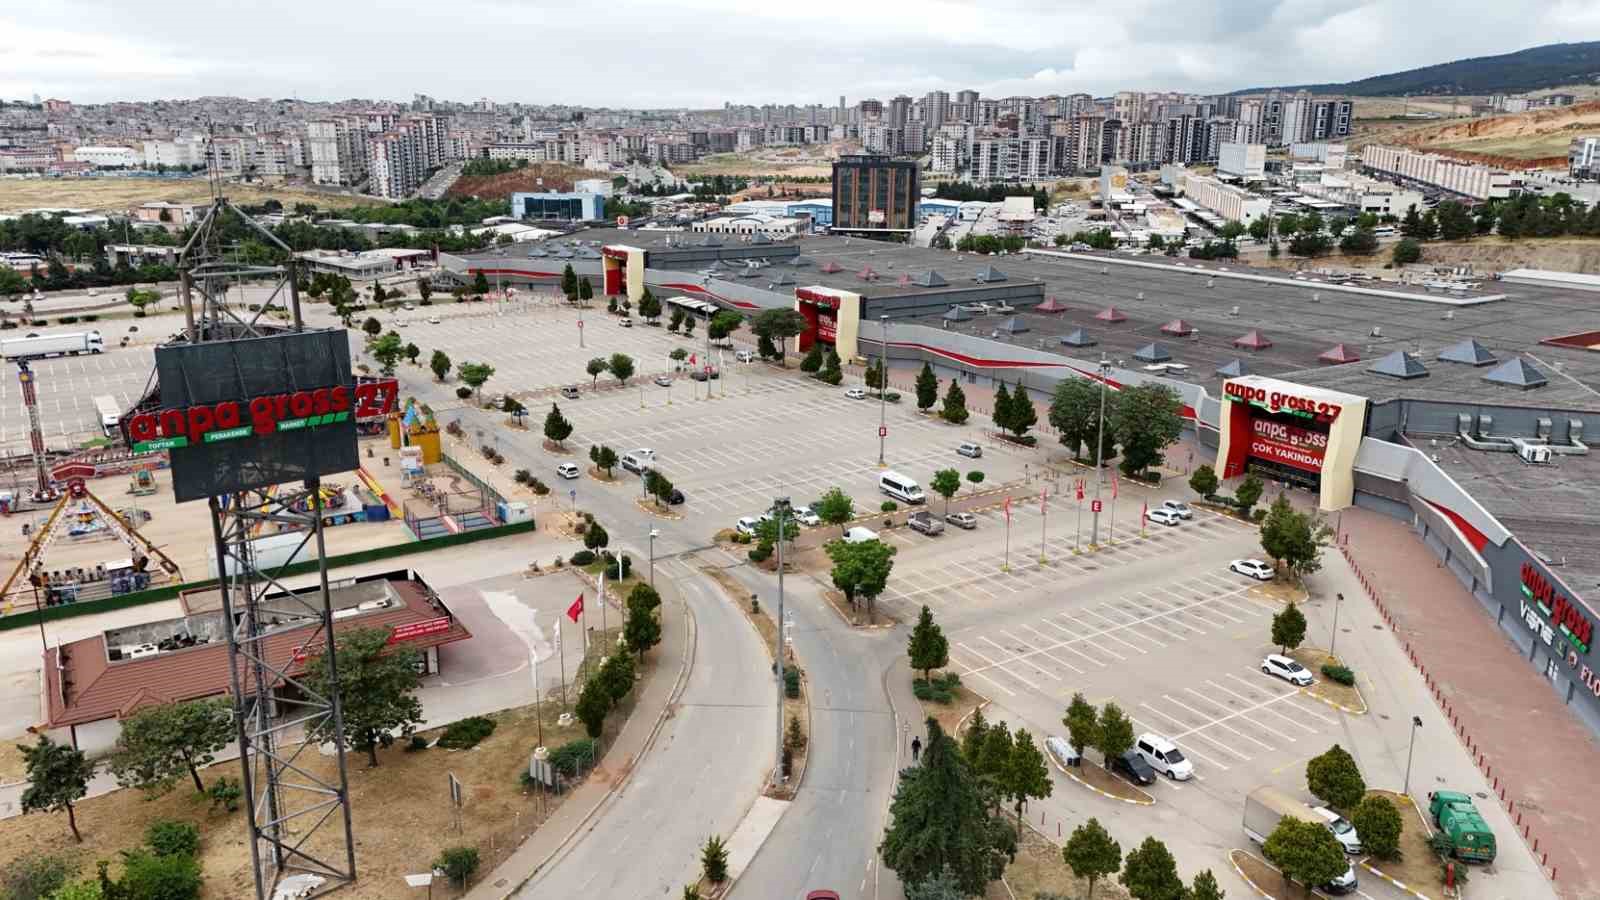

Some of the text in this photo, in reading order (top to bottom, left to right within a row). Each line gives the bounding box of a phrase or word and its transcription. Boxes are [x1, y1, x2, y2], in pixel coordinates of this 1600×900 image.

[130, 379, 398, 443] anpa gross 27
[1225, 382, 1266, 403] anpa
[1271, 392, 1315, 411] gross
[1318, 402, 1342, 420] 27
[1520, 561, 1592, 645] anpa gross
